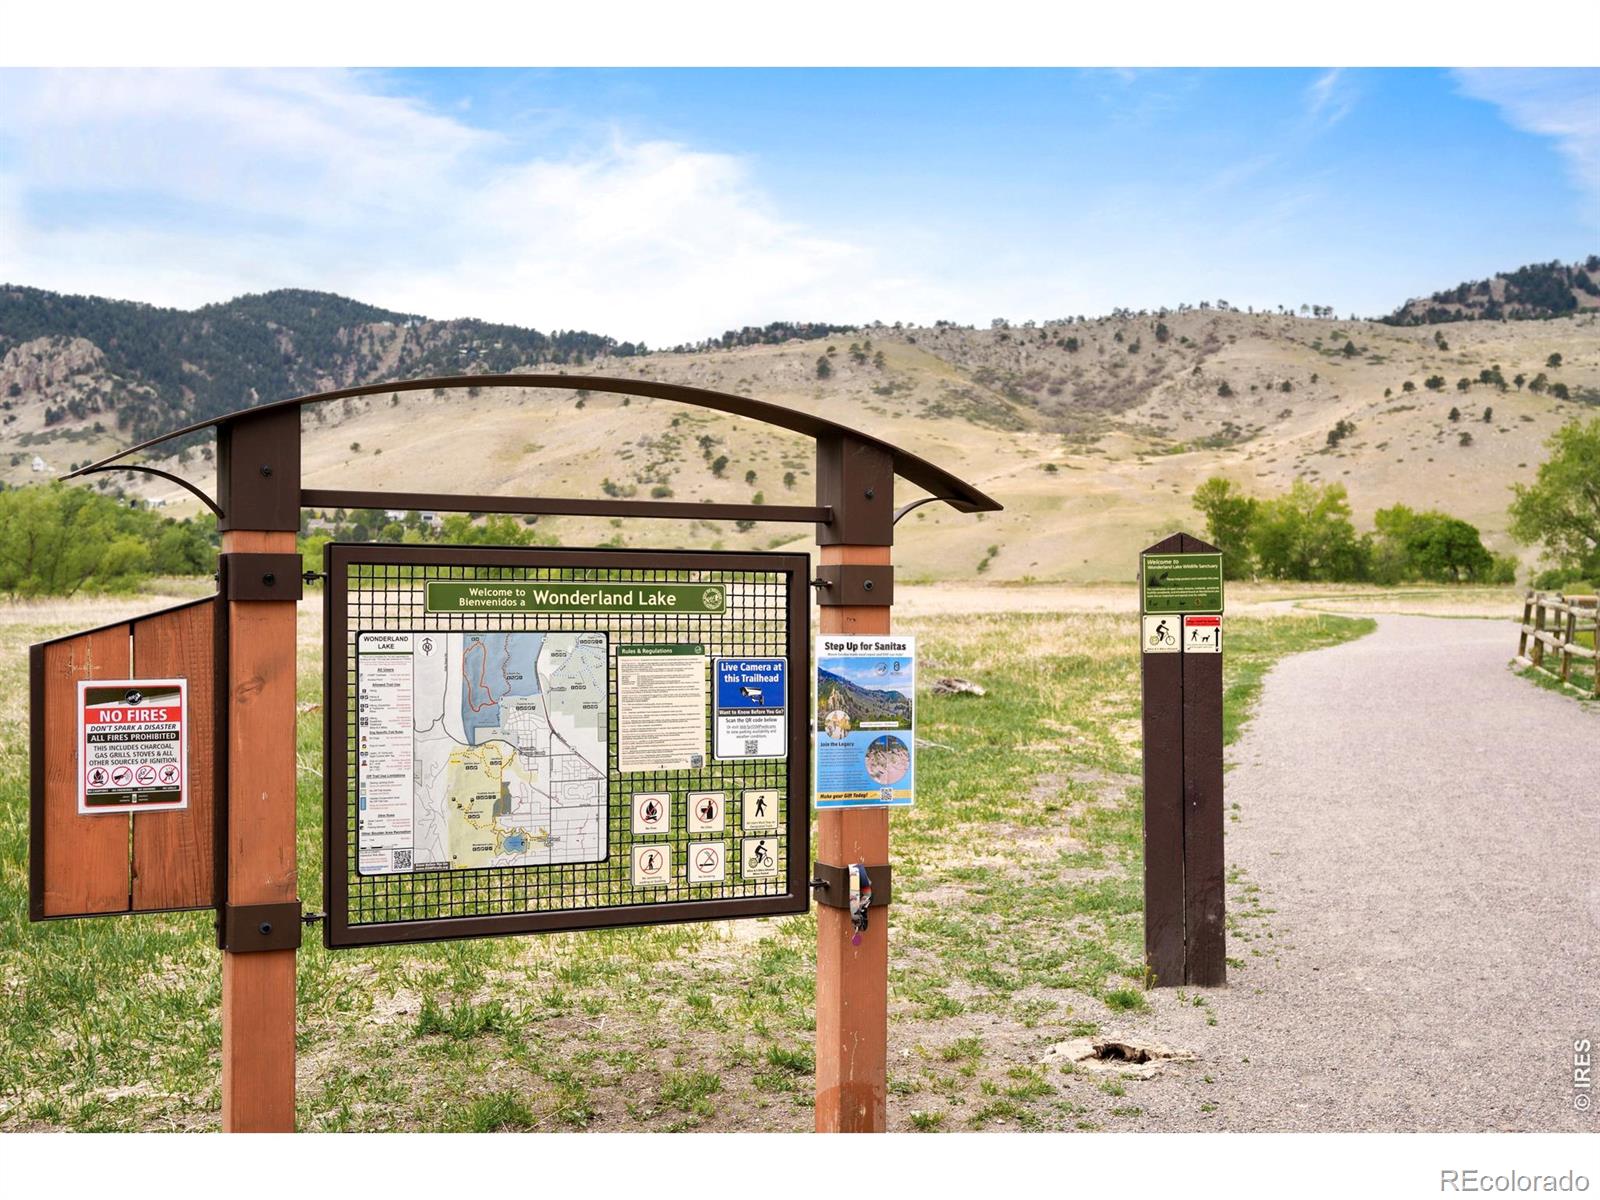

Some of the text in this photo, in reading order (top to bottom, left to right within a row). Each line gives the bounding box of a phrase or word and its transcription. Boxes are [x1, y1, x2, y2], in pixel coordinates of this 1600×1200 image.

[469, 588, 526, 596] Welcome to
[533, 590, 676, 605] Wonderland Lake
[459, 598, 517, 606] Bienvenidos
[825, 642, 906, 652] Step Up for Sanitas
[721, 663, 738, 671] Live
[740, 663, 771, 671] Camera
[724, 674, 779, 682] this Trailhead
[100, 708, 168, 722] NO FIRES
[130, 732, 176, 740] PROHIBITED
